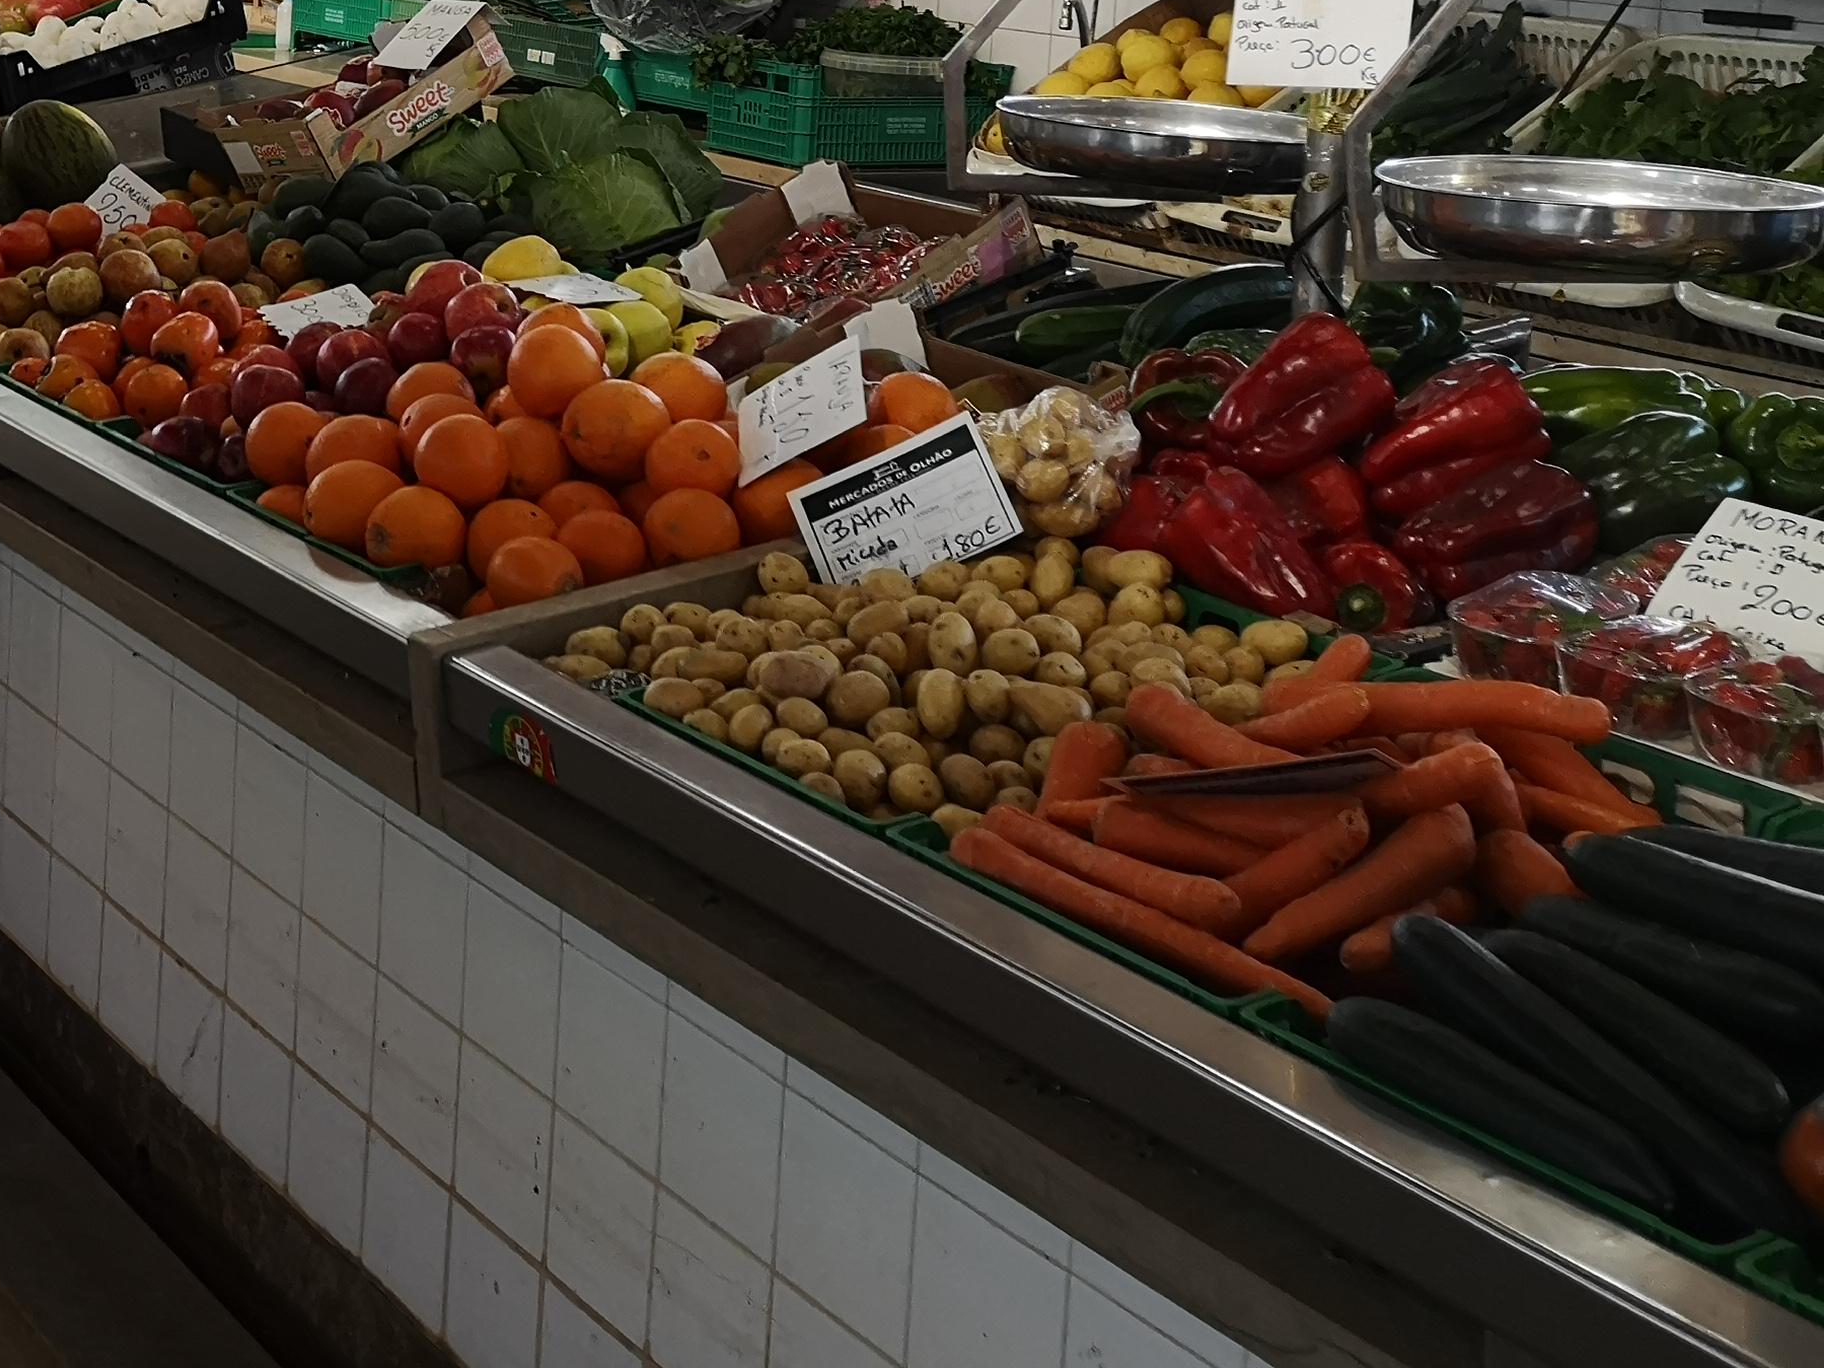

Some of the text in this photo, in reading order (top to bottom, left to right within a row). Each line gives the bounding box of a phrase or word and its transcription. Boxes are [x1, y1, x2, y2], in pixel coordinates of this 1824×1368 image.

[387, 81, 451, 135] Sweet
[416, 112, 439, 130] MANGO
[828, 475, 893, 510] MERCADOS
